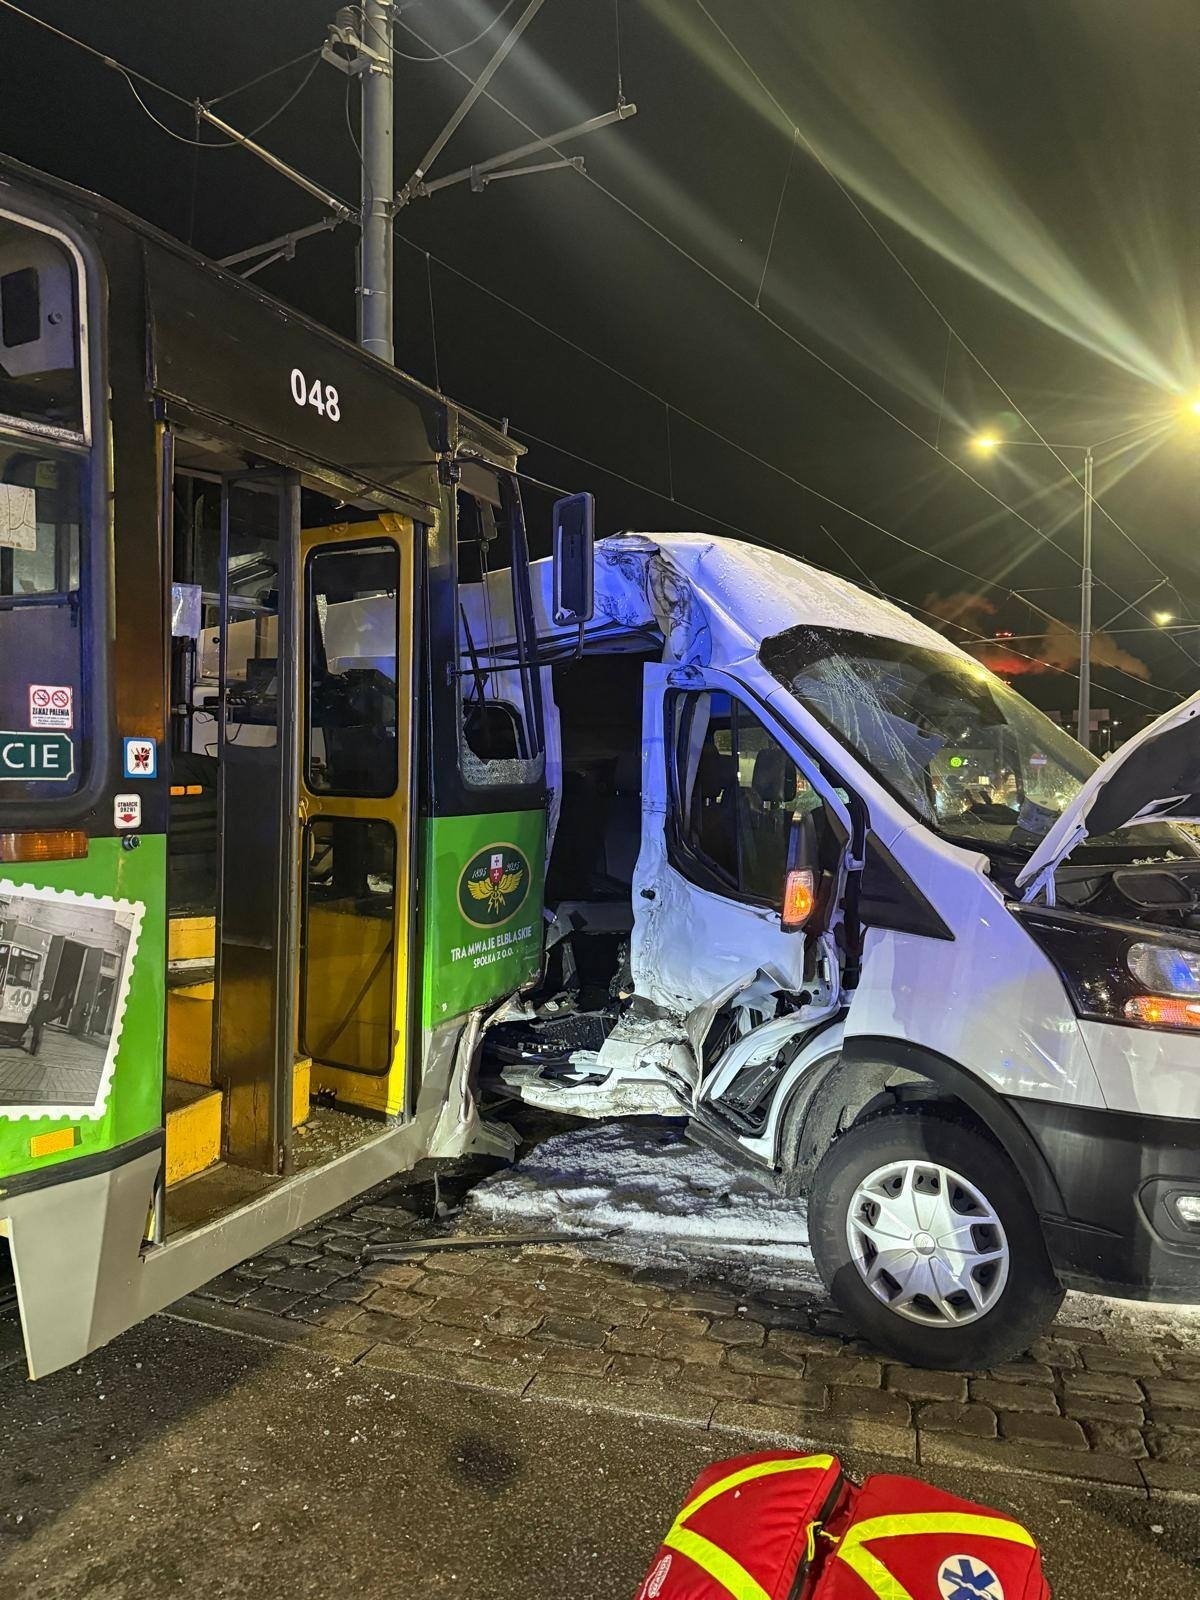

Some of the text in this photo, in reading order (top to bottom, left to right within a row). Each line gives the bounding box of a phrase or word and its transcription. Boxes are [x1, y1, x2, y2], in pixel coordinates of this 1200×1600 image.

[291, 368, 341, 422] 048
[32, 707, 70, 717] ZAKAZ PALENIA
[2, 743, 59, 768] CIE
[450, 937, 496, 962] TRAMWAJE
[473, 953, 496, 969] SPÓŁKA
[496, 951, 501, 960] Z
[10, 989, 32, 1008] 40
